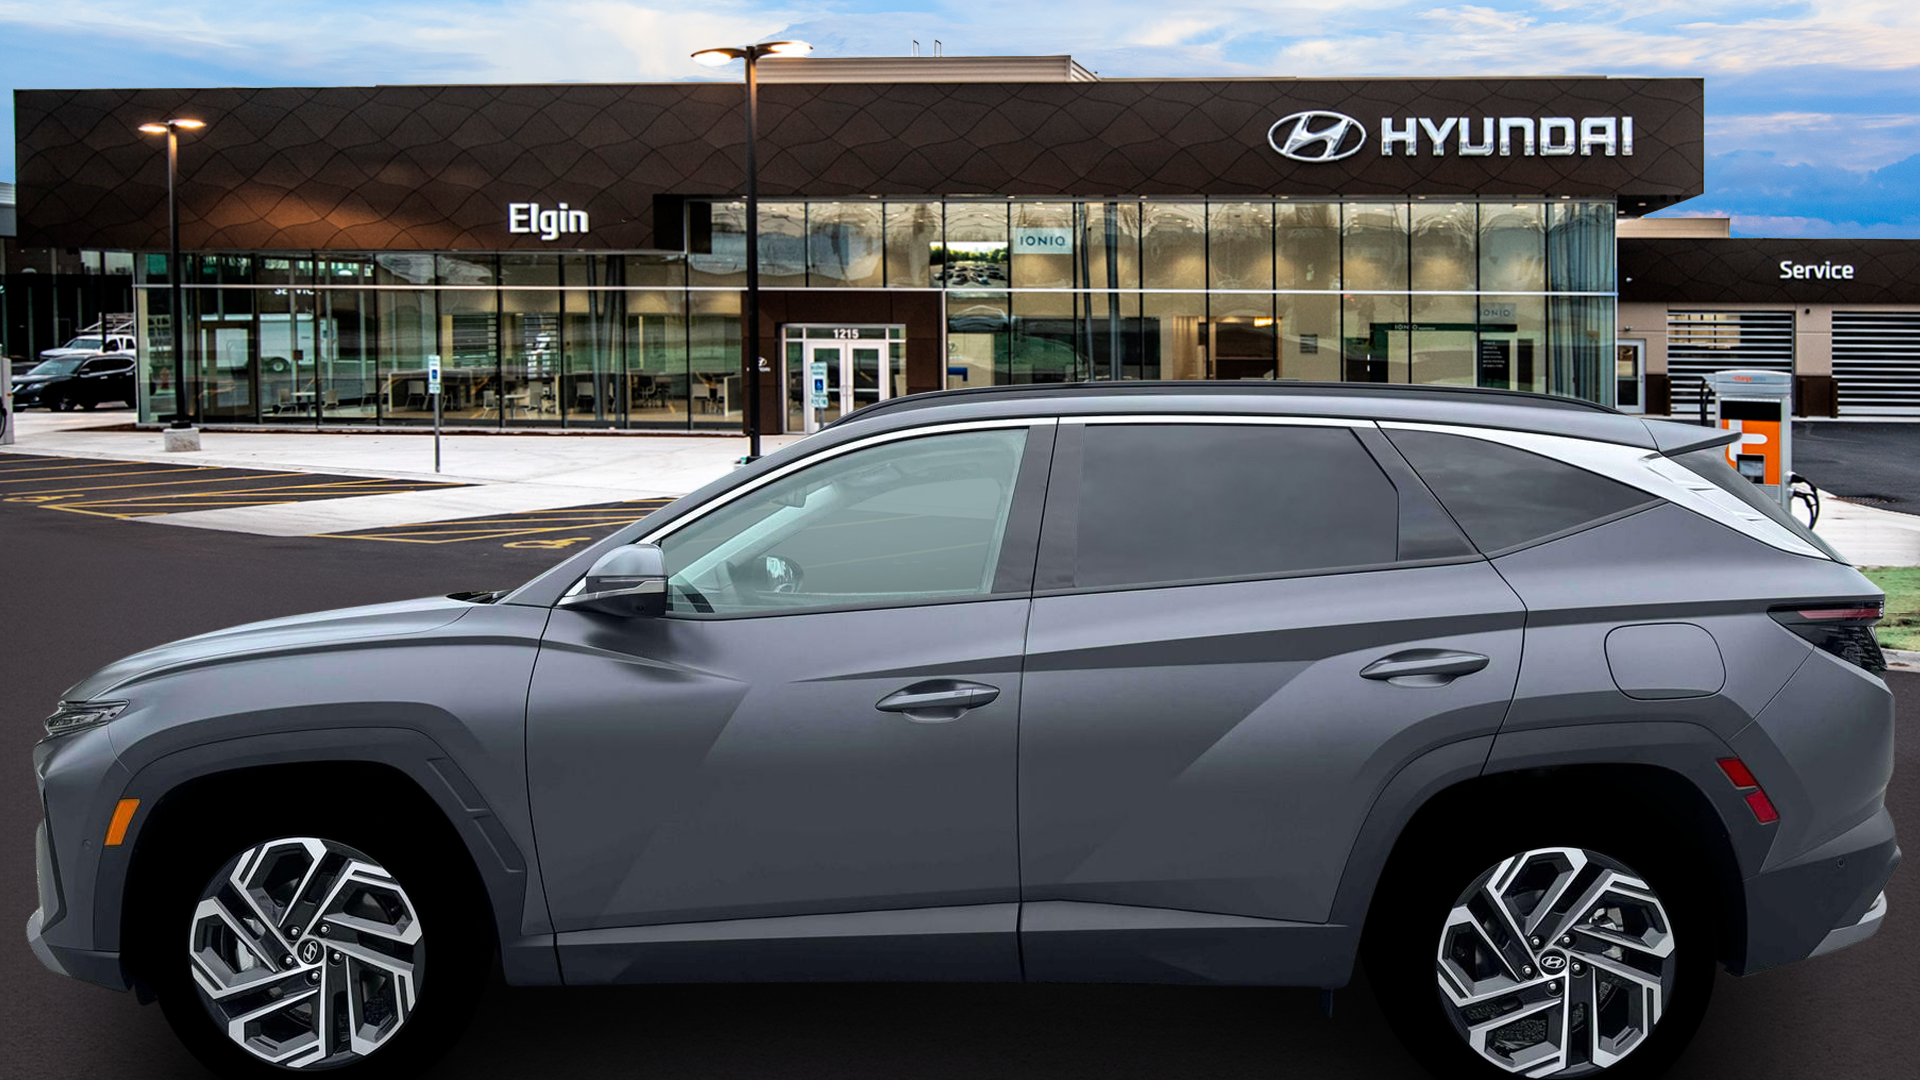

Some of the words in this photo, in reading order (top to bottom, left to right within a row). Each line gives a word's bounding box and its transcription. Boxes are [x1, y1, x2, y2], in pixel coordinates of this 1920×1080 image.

[1381, 117, 1633, 156] HYUNDAI
[509, 202, 590, 241] Elgin
[1020, 235, 1066, 247] IONIQ
[1779, 260, 1854, 279] Service
[833, 328, 859, 340] 1215
